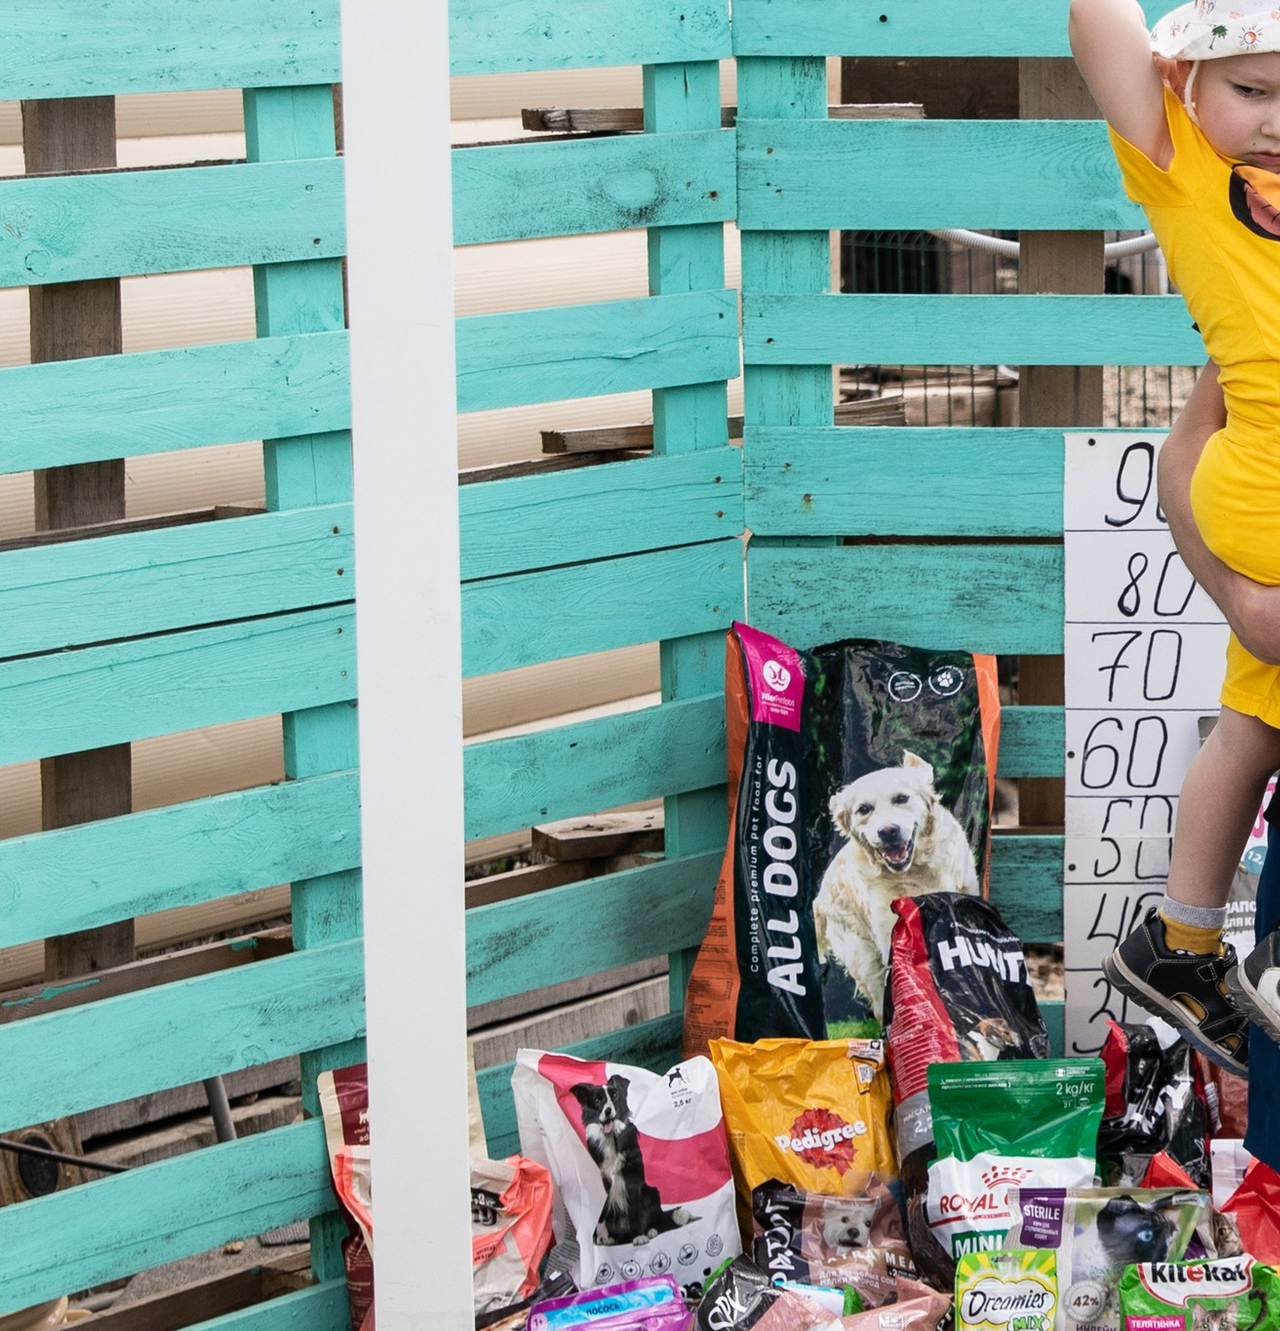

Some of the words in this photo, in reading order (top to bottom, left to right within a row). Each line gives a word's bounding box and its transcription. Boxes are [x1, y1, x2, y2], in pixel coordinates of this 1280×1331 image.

[1104, 442, 1167, 527] 9
[1117, 551, 1197, 617] 80
[1091, 630, 1182, 702] 70
[754, 754, 762, 777] for
[1080, 716, 1167, 790] 60
[751, 780, 761, 812] food
[749, 817, 760, 841] pet
[762, 757, 799, 898] DOGS
[749, 845, 760, 903] premium
[749, 907, 759, 973] Complete
[766, 909, 807, 997] ALL
[937, 935, 1033, 988] HUNT
[773, 1119, 868, 1155] Pedigree
[939, 1193, 999, 1216] ROYAL
[1023, 1204, 1061, 1221] STERILE
[884, 1252, 917, 1272] MEA
[955, 1235, 1003, 1259] MINI
[1151, 1260, 1246, 1284] kitekat
[968, 1289, 1049, 1318] Dreamies
[1072, 1294, 1100, 1308] 42%
